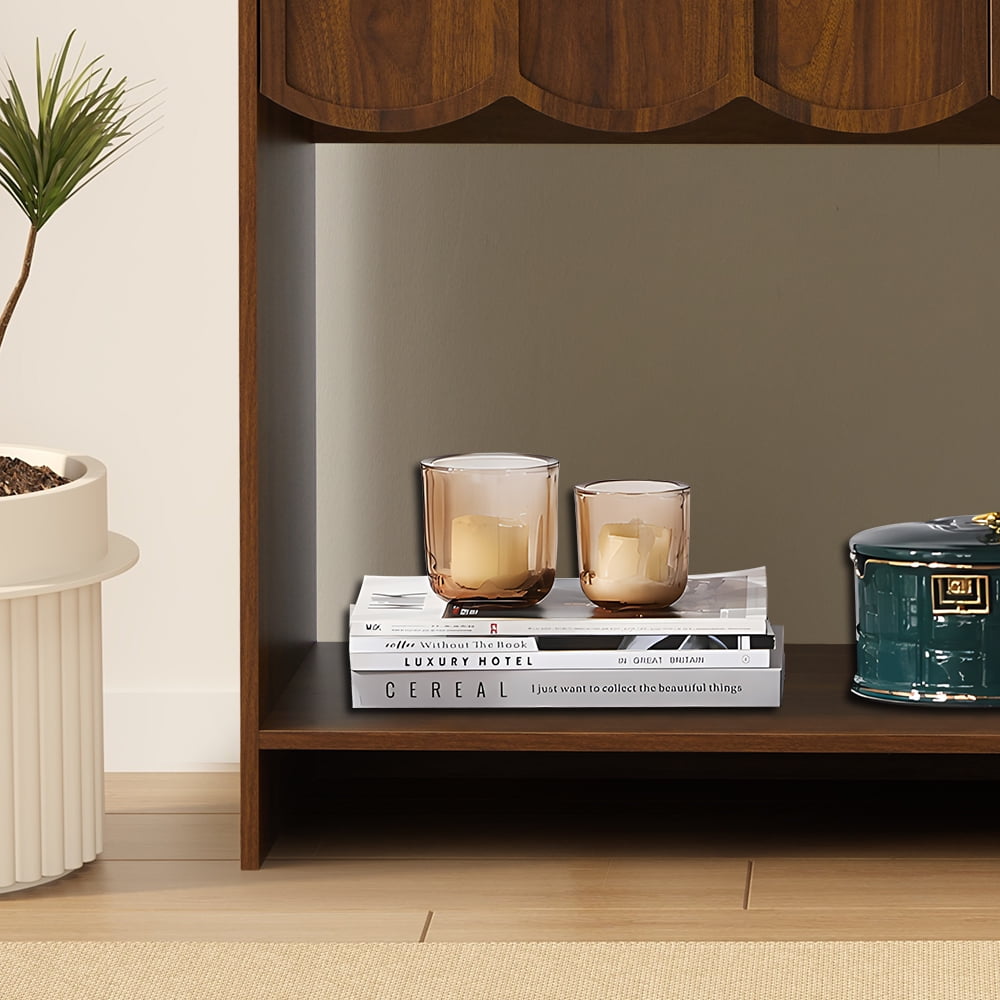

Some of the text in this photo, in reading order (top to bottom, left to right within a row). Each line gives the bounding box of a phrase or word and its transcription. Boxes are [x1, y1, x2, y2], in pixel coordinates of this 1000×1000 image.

[420, 640, 470, 649] Without
[472, 640, 494, 649] The
[497, 640, 528, 649] Book
[404, 656, 533, 667] LUXURY HOTEL
[385, 681, 507, 699] CEREAL
[536, 683, 557, 695] just
[560, 684, 586, 693] want
[589, 684, 600, 693] to
[602, 683, 636, 693] collect
[639, 683, 656, 693] the
[658, 683, 706, 693] beautiful
[709, 683, 742, 694] things
